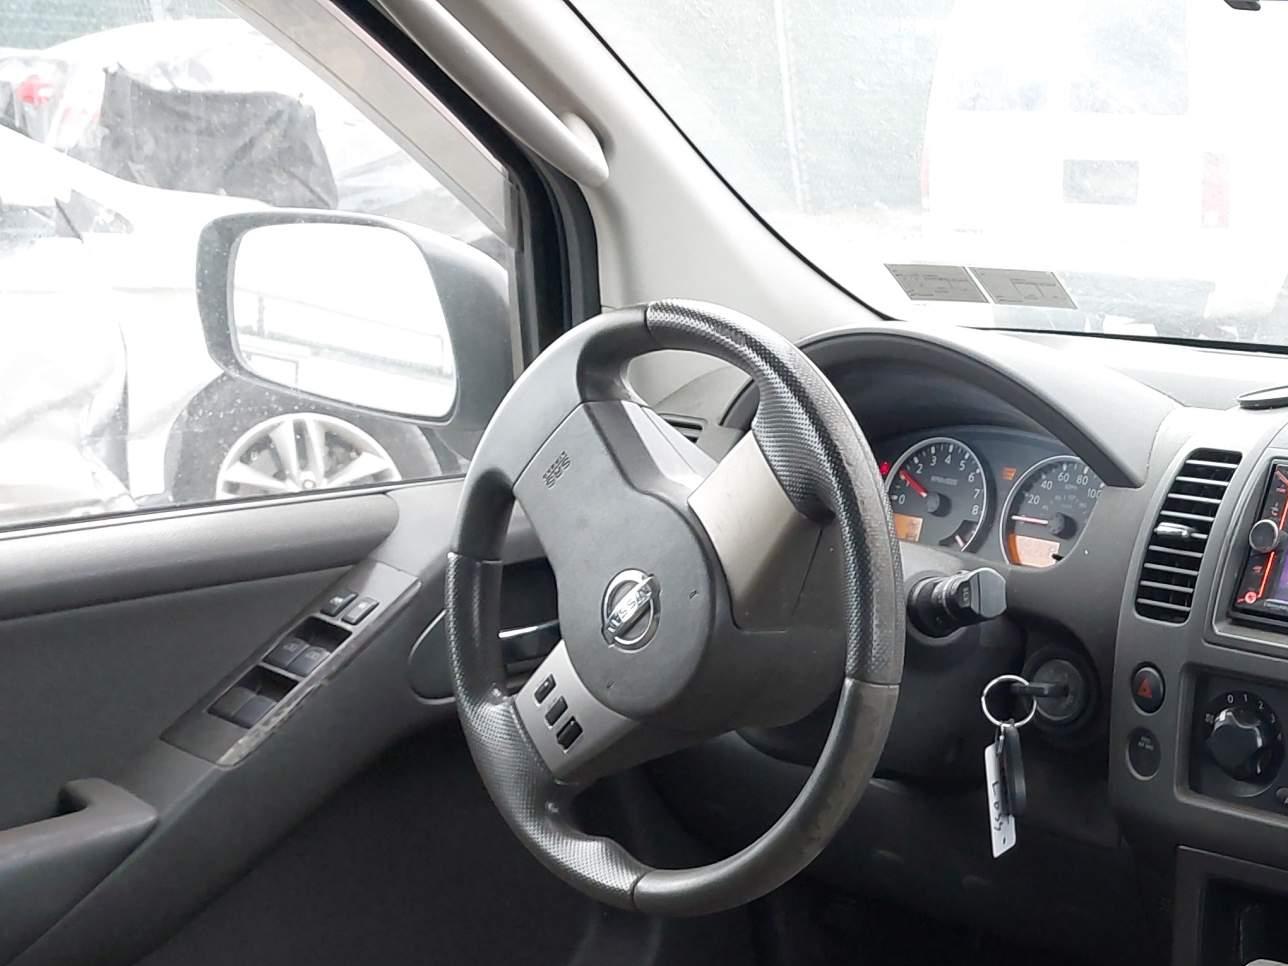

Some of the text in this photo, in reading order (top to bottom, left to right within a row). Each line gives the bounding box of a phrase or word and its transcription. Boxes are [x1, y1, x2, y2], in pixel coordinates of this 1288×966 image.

[930, 455, 937, 467] 3
[944, 453, 952, 465] 4
[916, 463, 924, 474] 2
[959, 460, 966, 471] 5
[968, 472, 976, 483] 6
[1057, 471, 1070, 483] 60
[1076, 474, 1089, 486] 80
[1041, 480, 1053, 491] 40
[898, 494, 906, 504] 0
[973, 488, 980, 499] 7
[1027, 494, 1040, 505] 20
[971, 504, 979, 515] 8
[1227, 694, 1234, 704] 0
[1243, 693, 1248, 702] 1
[1258, 700, 1264, 710] 2
